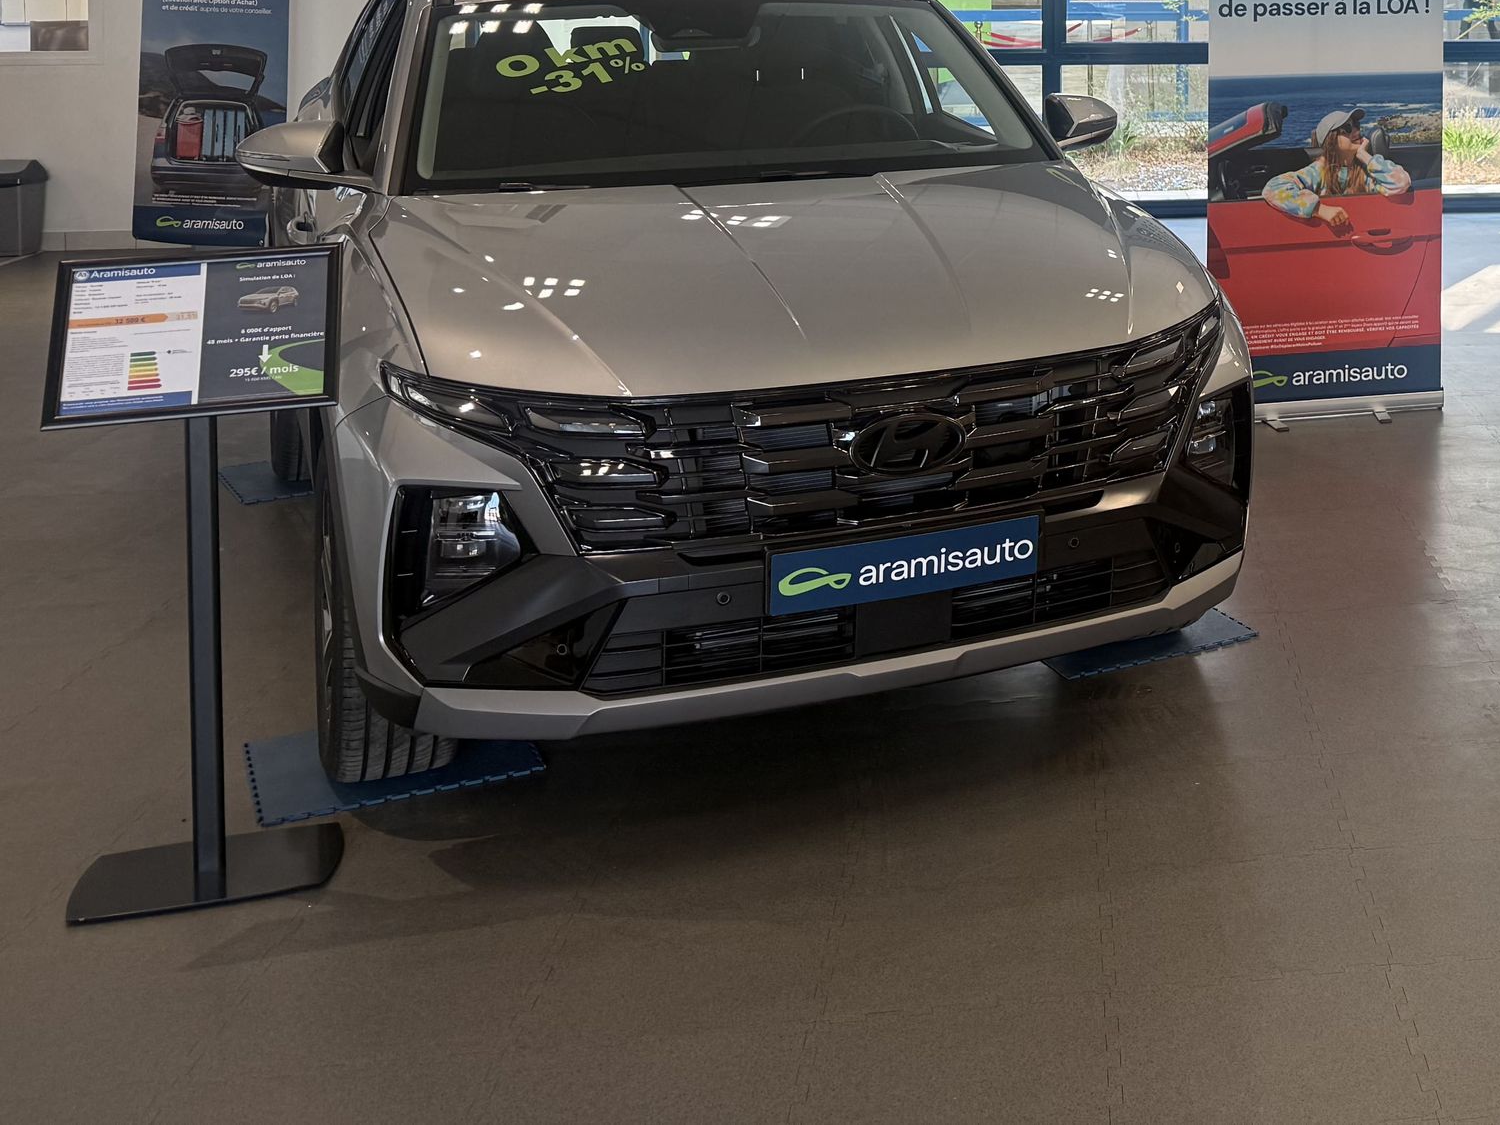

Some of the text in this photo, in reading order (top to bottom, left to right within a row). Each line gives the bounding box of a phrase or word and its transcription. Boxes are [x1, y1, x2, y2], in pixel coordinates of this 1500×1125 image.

[1218, 0, 1247, 17] de
[1253, 0, 1330, 22] passer
[544, 38, 637, 67] km
[530, 56, 645, 95] -31%
[183, 218, 244, 230] aramisauto
[256, 259, 307, 268] aramisauto
[90, 267, 156, 279] Aramisauto
[240, 335, 270, 343] Garantie
[229, 367, 258, 378] 295€
[270, 363, 299, 374] mois
[1292, 362, 1408, 386] aramisauto
[858, 538, 1034, 586] aramisauto
